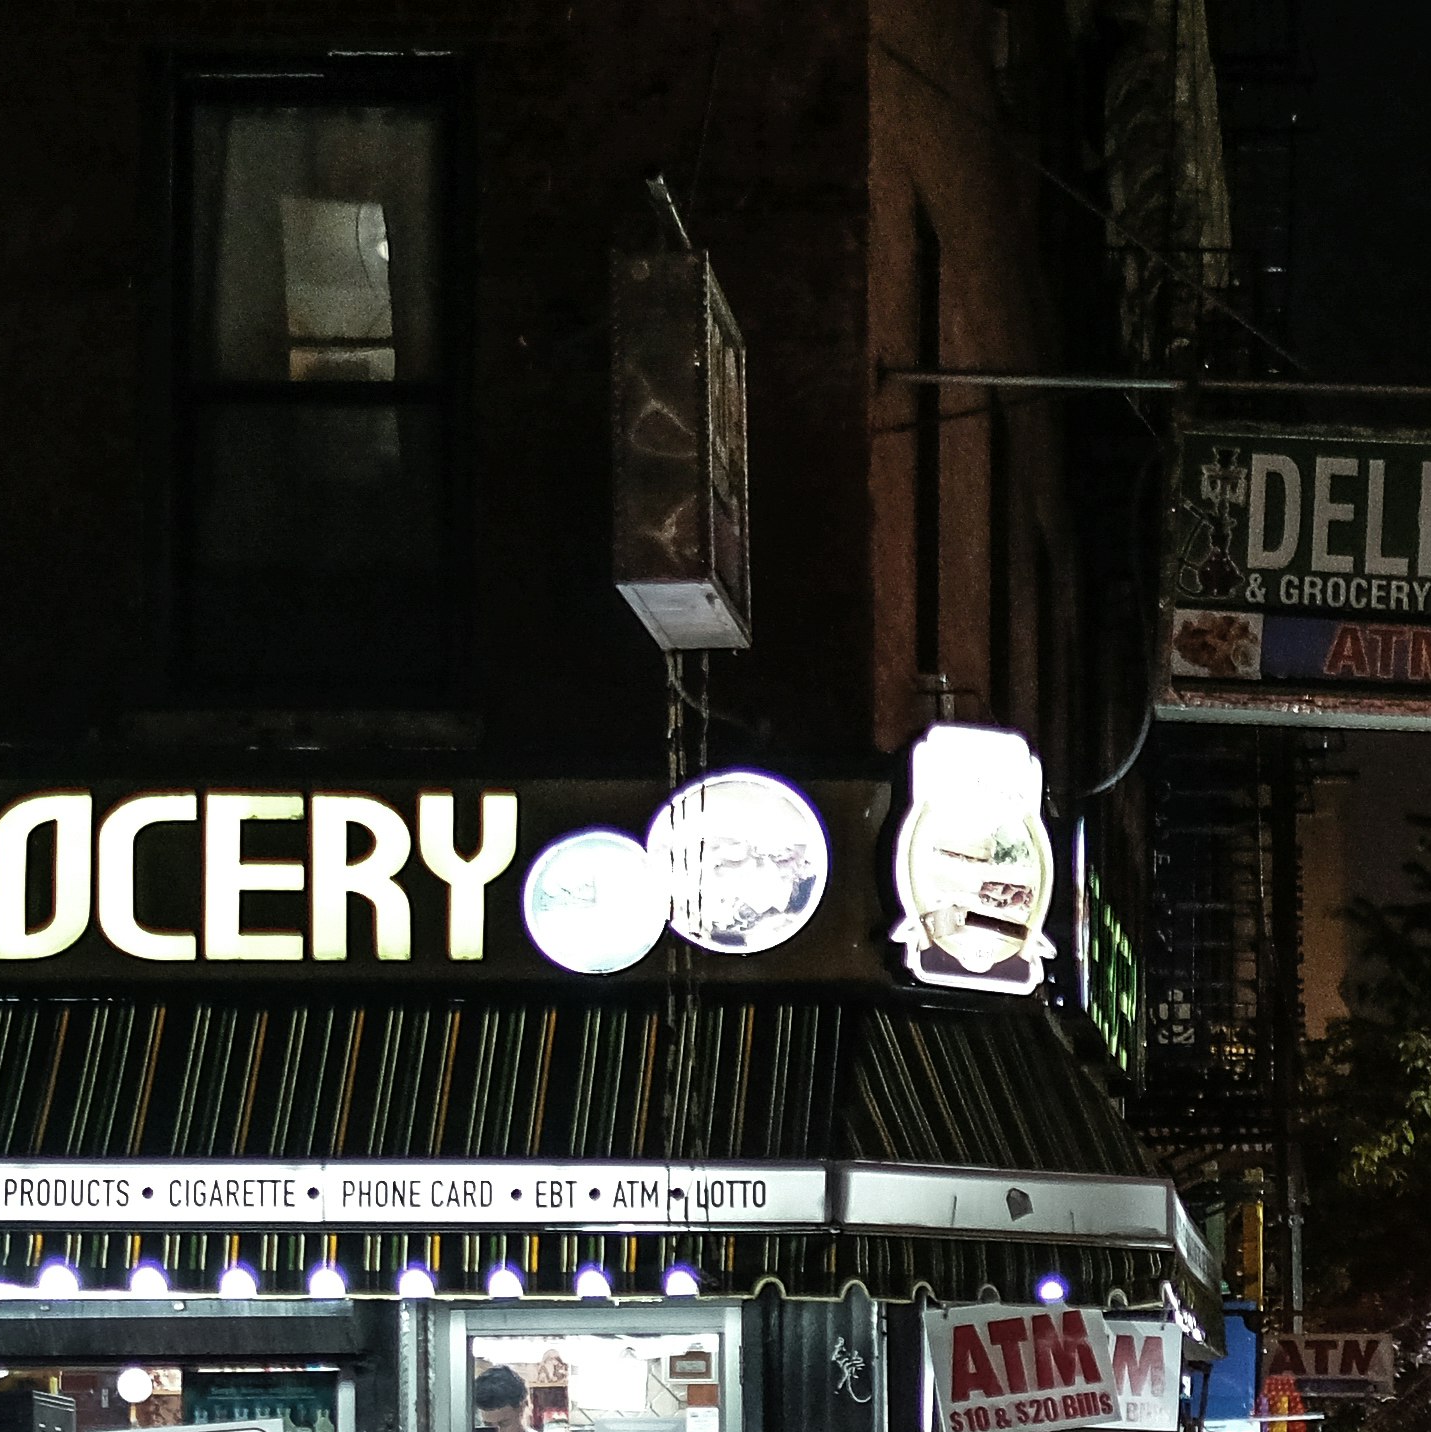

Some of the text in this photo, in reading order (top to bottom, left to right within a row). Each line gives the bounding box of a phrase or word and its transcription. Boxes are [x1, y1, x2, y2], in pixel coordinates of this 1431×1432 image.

[1245, 575, 1431, 612] & GROCERY
[4, 1179, 130, 1207] PRODUCTS
[169, 1179, 296, 1208] CIGARETTE
[343, 1180, 421, 1208] PHONE
[431, 1180, 493, 1208] CARD
[535, 1180, 577, 1208] EBT
[613, 1180, 659, 1208] ATM
[695, 1180, 766, 1208] LOTTO
[951, 1310, 1103, 1403] ATM
[994, 1404, 1013, 1430] &
[1015, 1398, 1058, 1425] $20
